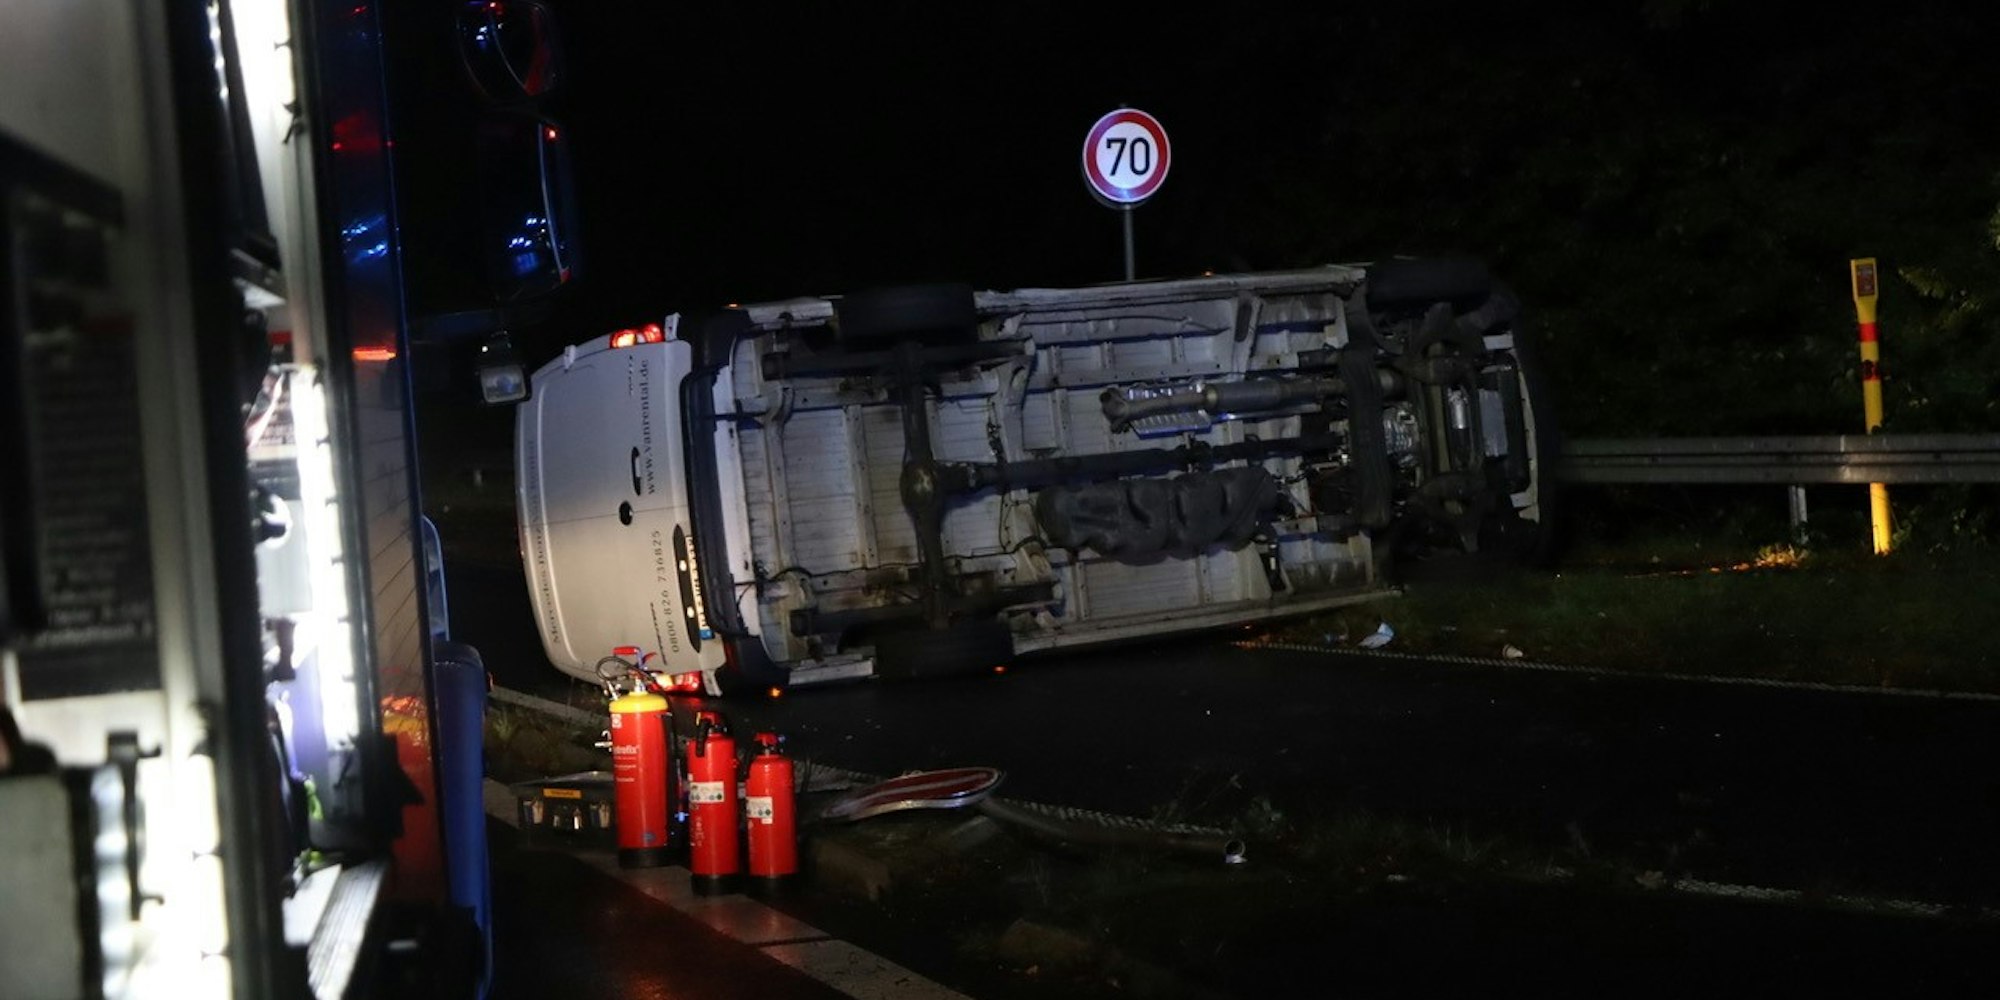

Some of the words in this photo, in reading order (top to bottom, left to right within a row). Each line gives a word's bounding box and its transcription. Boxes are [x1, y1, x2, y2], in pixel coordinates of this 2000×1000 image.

[1106, 137, 1150, 176] 70
[640, 359, 655, 495] www.vanrental.de
[652, 530, 667, 582] 736825
[661, 590, 673, 615] 826
[666, 620, 680, 653] 0800
